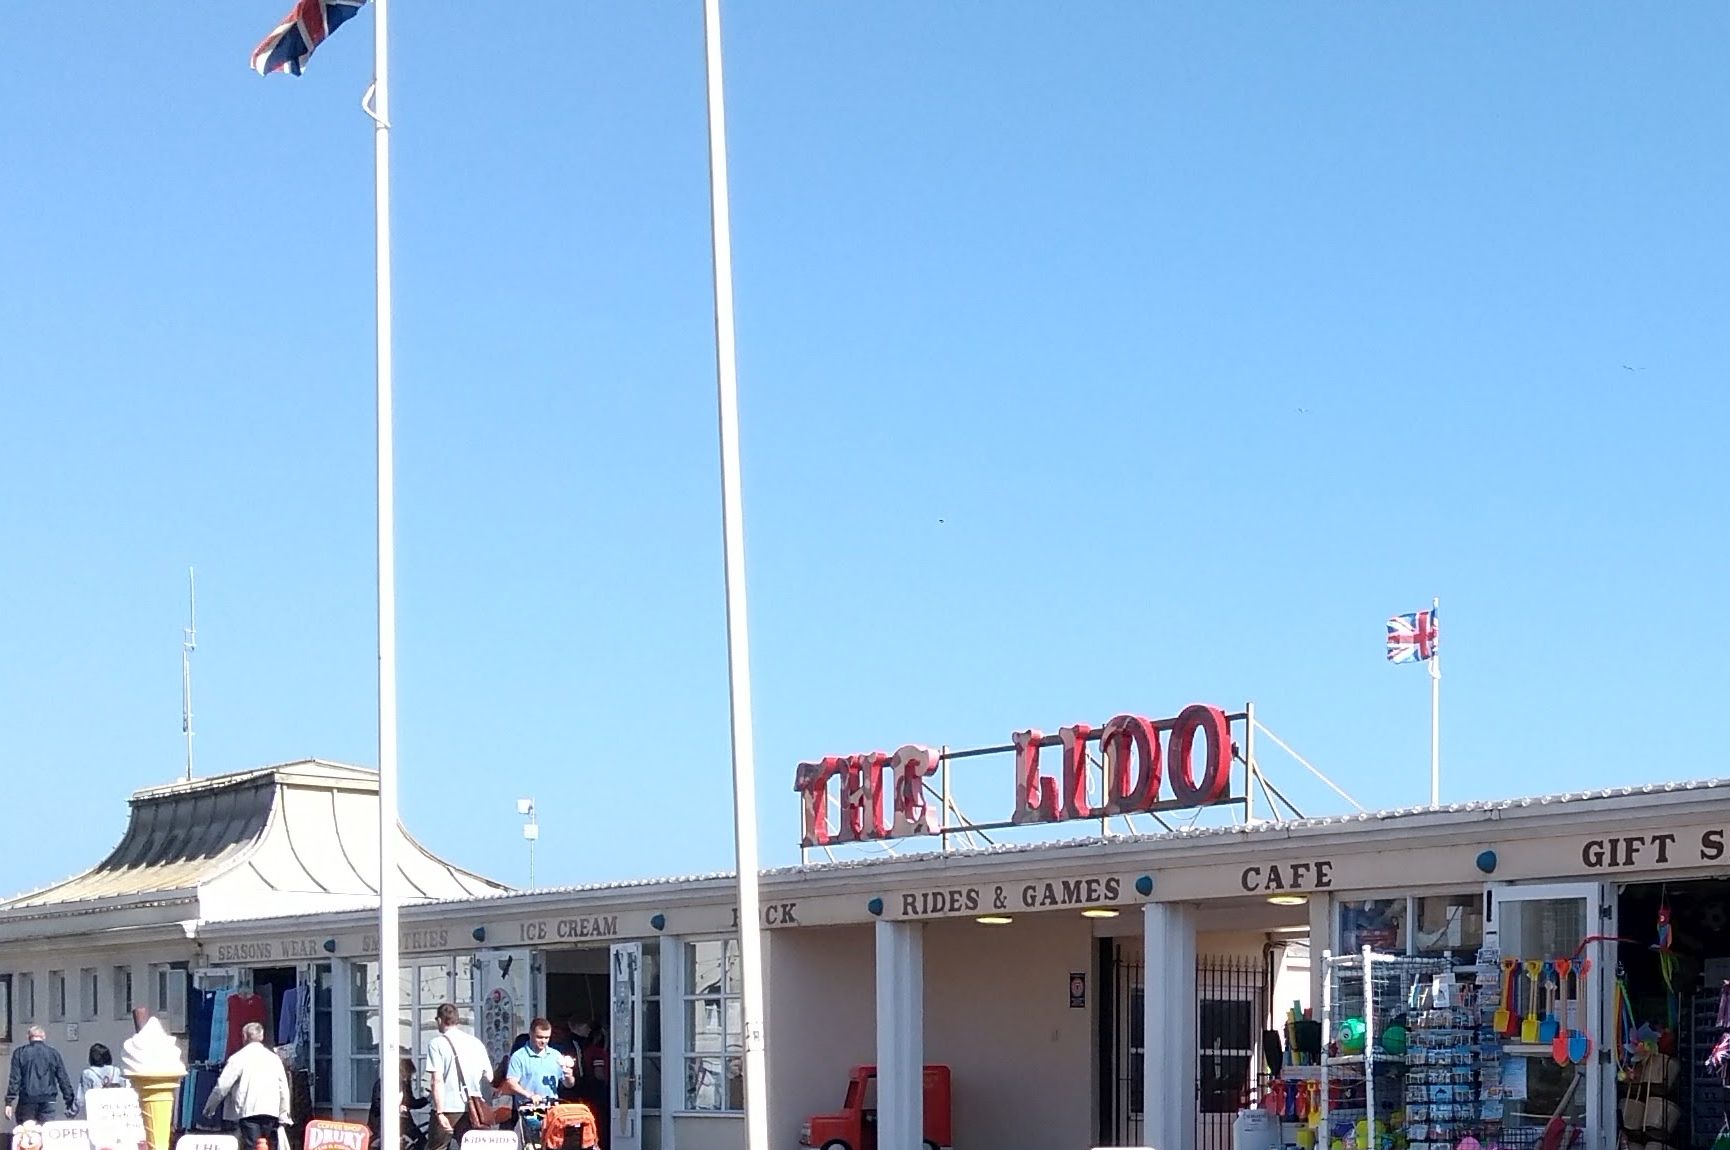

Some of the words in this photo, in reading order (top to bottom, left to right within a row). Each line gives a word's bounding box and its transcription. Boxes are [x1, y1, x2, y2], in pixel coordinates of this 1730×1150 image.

[794, 744, 941, 846] THE
[1012, 704, 1230, 824] LIDO
[1582, 834, 1677, 868] GIFT
[1242, 861, 1333, 892] CAFE
[902, 888, 980, 916] RIDES
[993, 886, 1008, 910] &
[1022, 877, 1121, 907] GAMES
[520, 921, 547, 941] ICE
[557, 916, 618, 938] CREAM
[217, 943, 272, 961] SEASONS
[280, 940, 317, 957] WEAR
